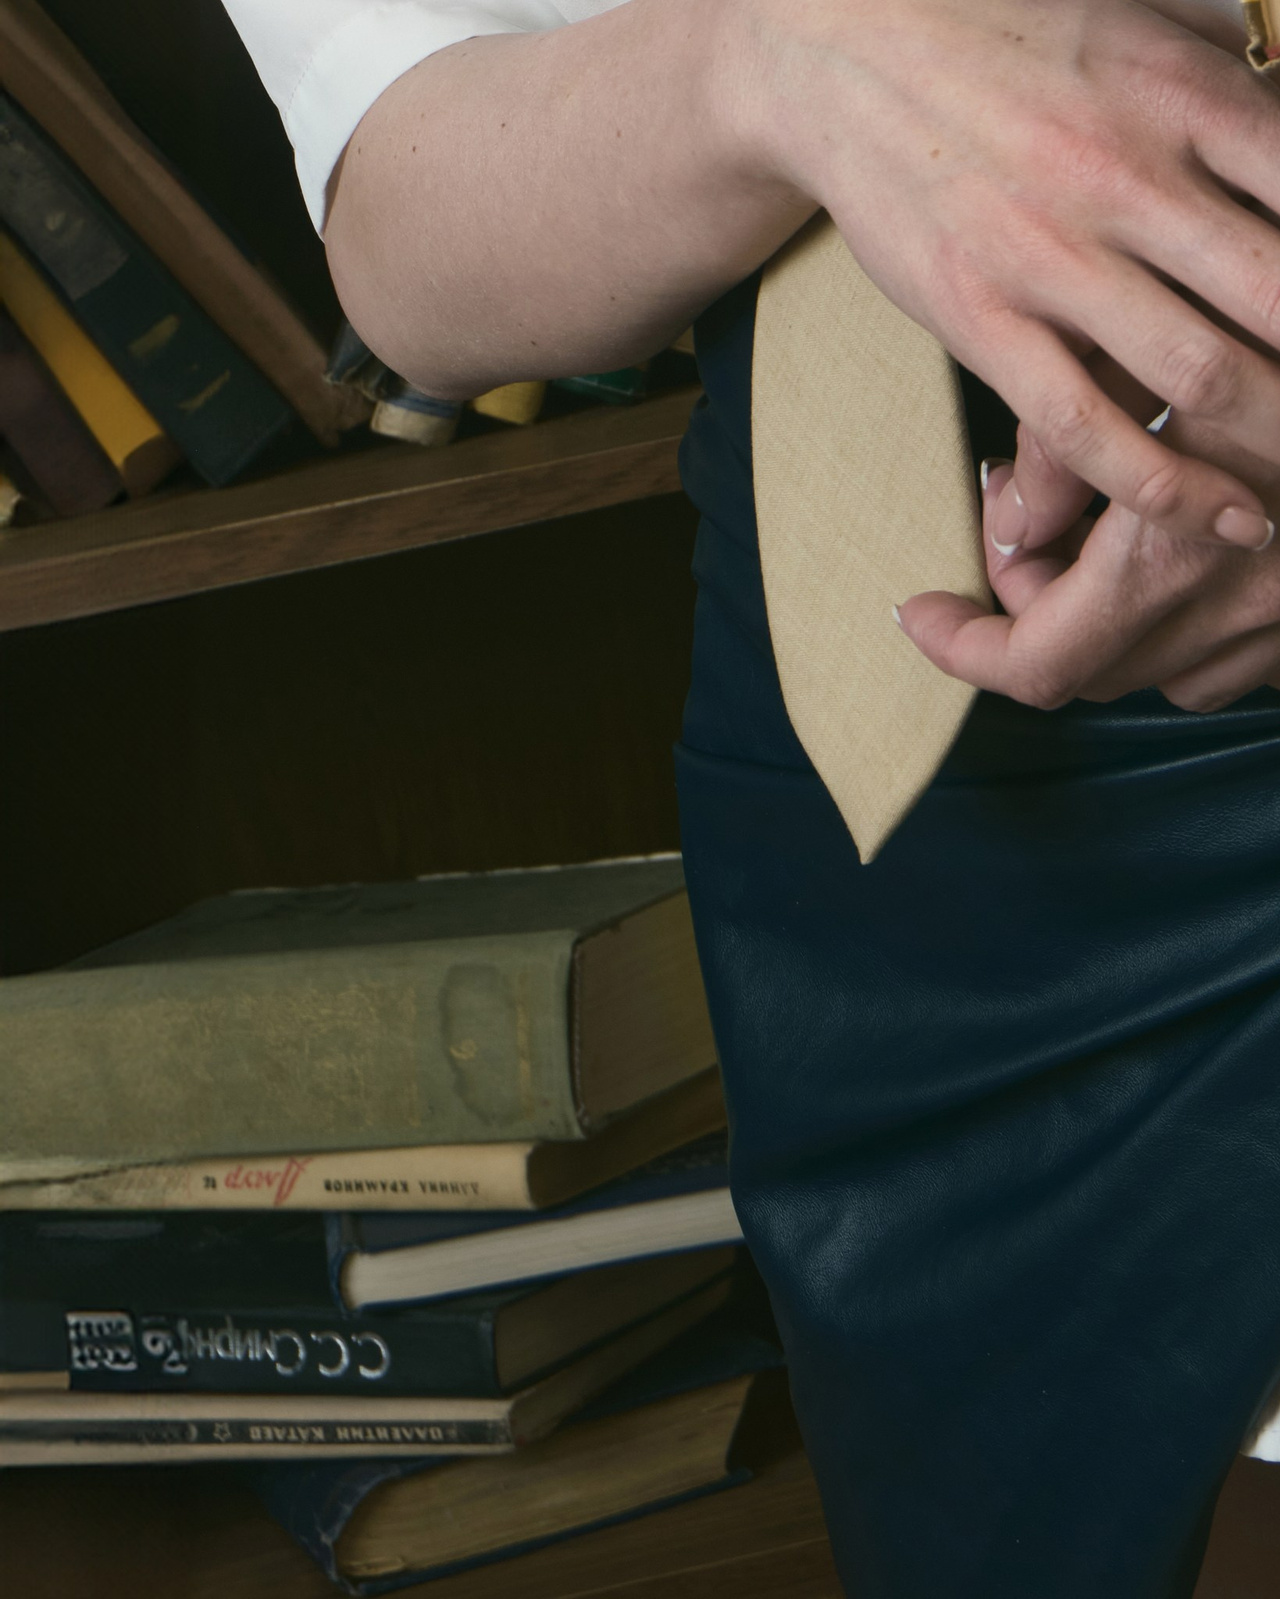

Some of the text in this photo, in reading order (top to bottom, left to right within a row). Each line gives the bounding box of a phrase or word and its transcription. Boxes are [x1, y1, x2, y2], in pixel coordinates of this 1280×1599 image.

[323, 1177, 410, 1195] КРАМИНОВ
[249, 1422, 446, 1441] ВАЛЕНТИН КАТАЕВ
